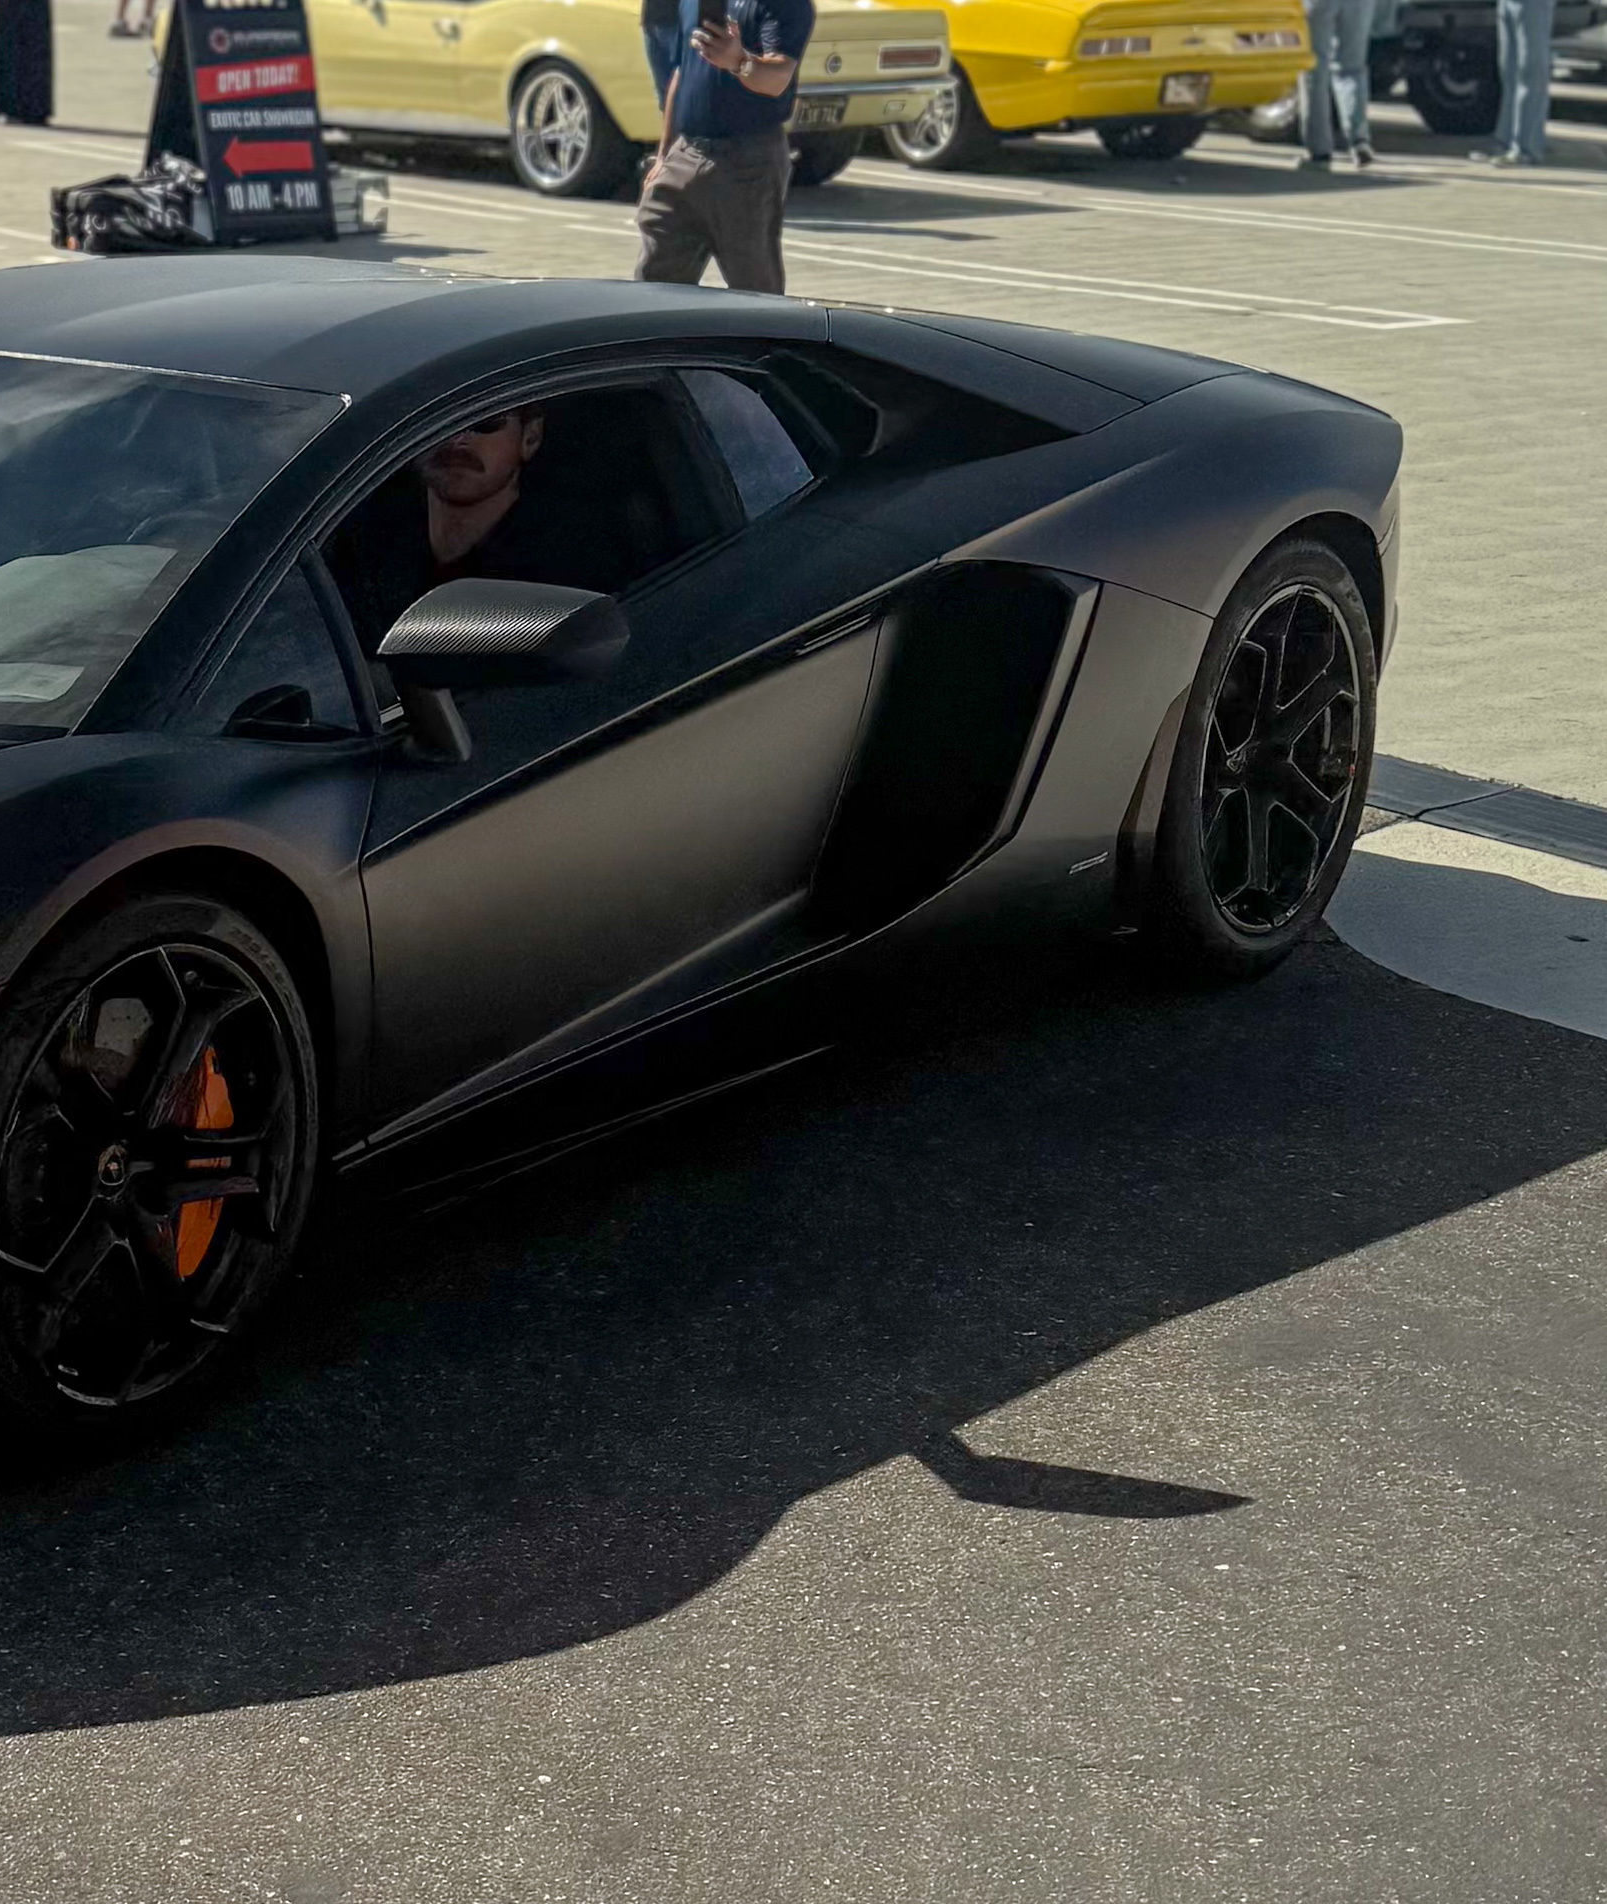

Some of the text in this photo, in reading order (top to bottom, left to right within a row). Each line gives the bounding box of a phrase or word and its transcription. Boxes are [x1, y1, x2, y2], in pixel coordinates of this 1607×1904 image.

[217, 62, 299, 94] OPEN TODAY!
[209, 108, 315, 129] EXOTIC CAR SHOWROOM
[227, 184, 244, 210] 10
[247, 183, 271, 209] AM
[283, 182, 292, 208] 4
[294, 181, 319, 207] PM
